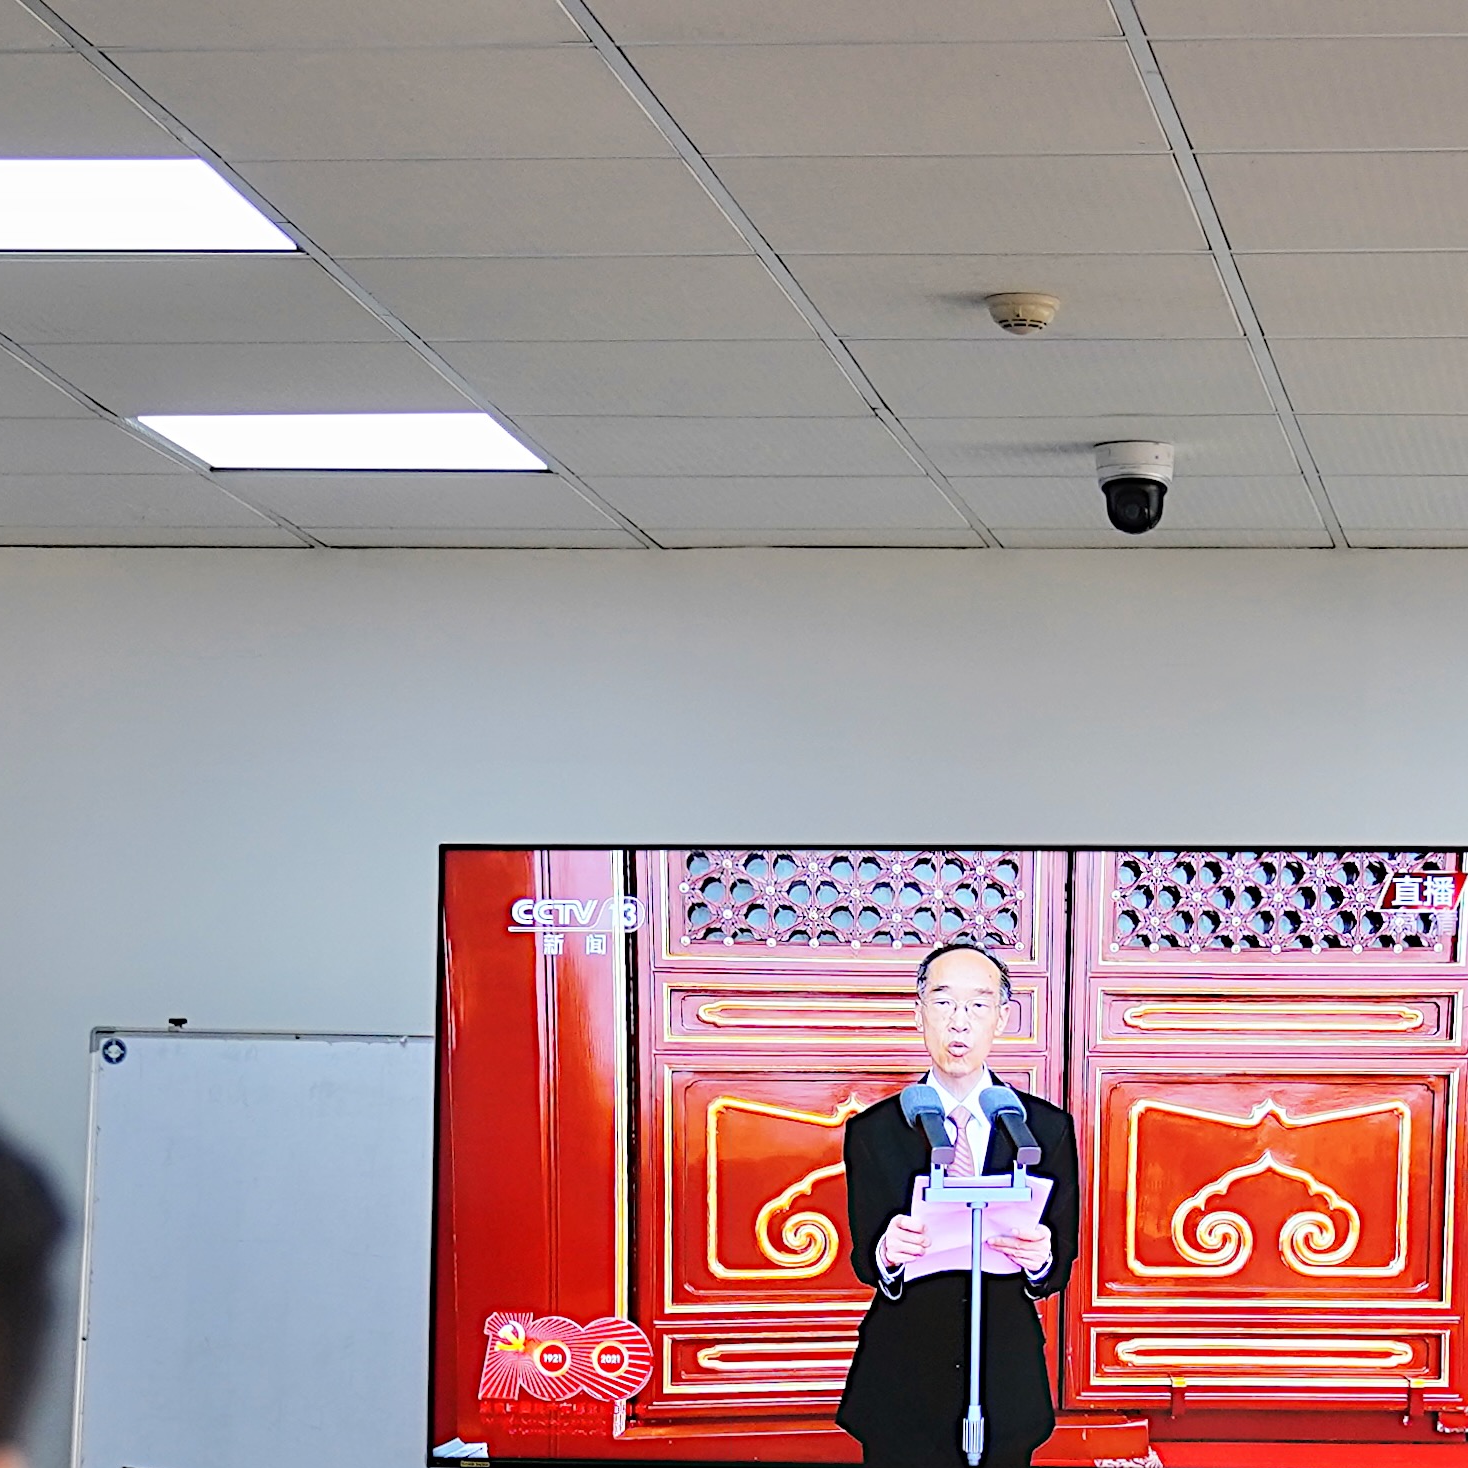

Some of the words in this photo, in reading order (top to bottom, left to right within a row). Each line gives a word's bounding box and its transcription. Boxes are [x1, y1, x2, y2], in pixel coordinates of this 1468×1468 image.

[1391, 874, 1456, 907] 直播
[511, 898, 599, 925] CCTV
[543, 933, 607, 956] 新闻
[542, 1352, 563, 1364] 1921
[600, 1354, 621, 1364] 2021
